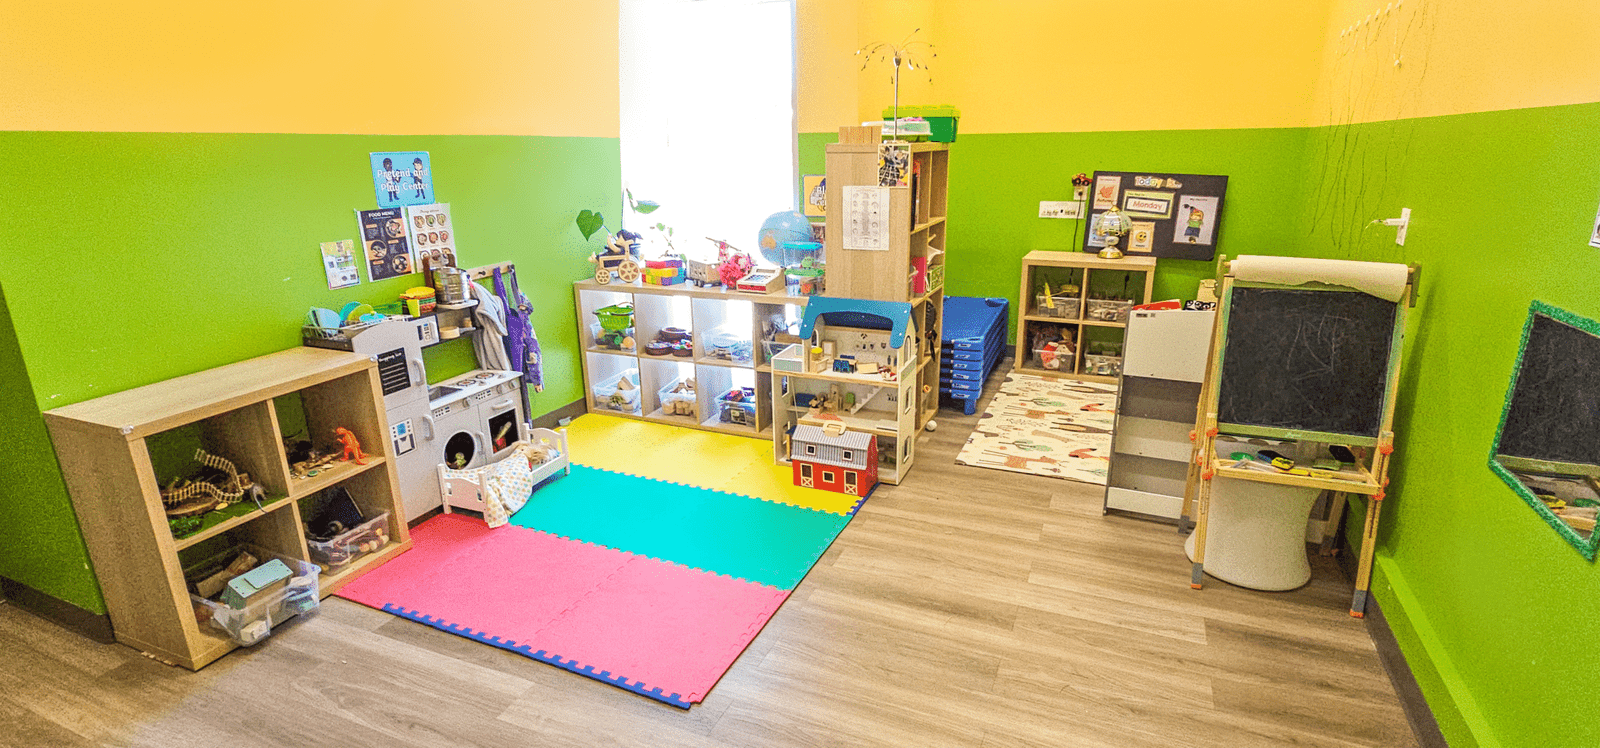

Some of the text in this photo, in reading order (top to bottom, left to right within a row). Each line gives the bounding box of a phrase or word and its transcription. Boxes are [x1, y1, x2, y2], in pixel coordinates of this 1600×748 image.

[377, 168, 429, 179] Pretend and
[380, 181, 429, 194] Play Center
[1132, 200, 1163, 212] Monday
